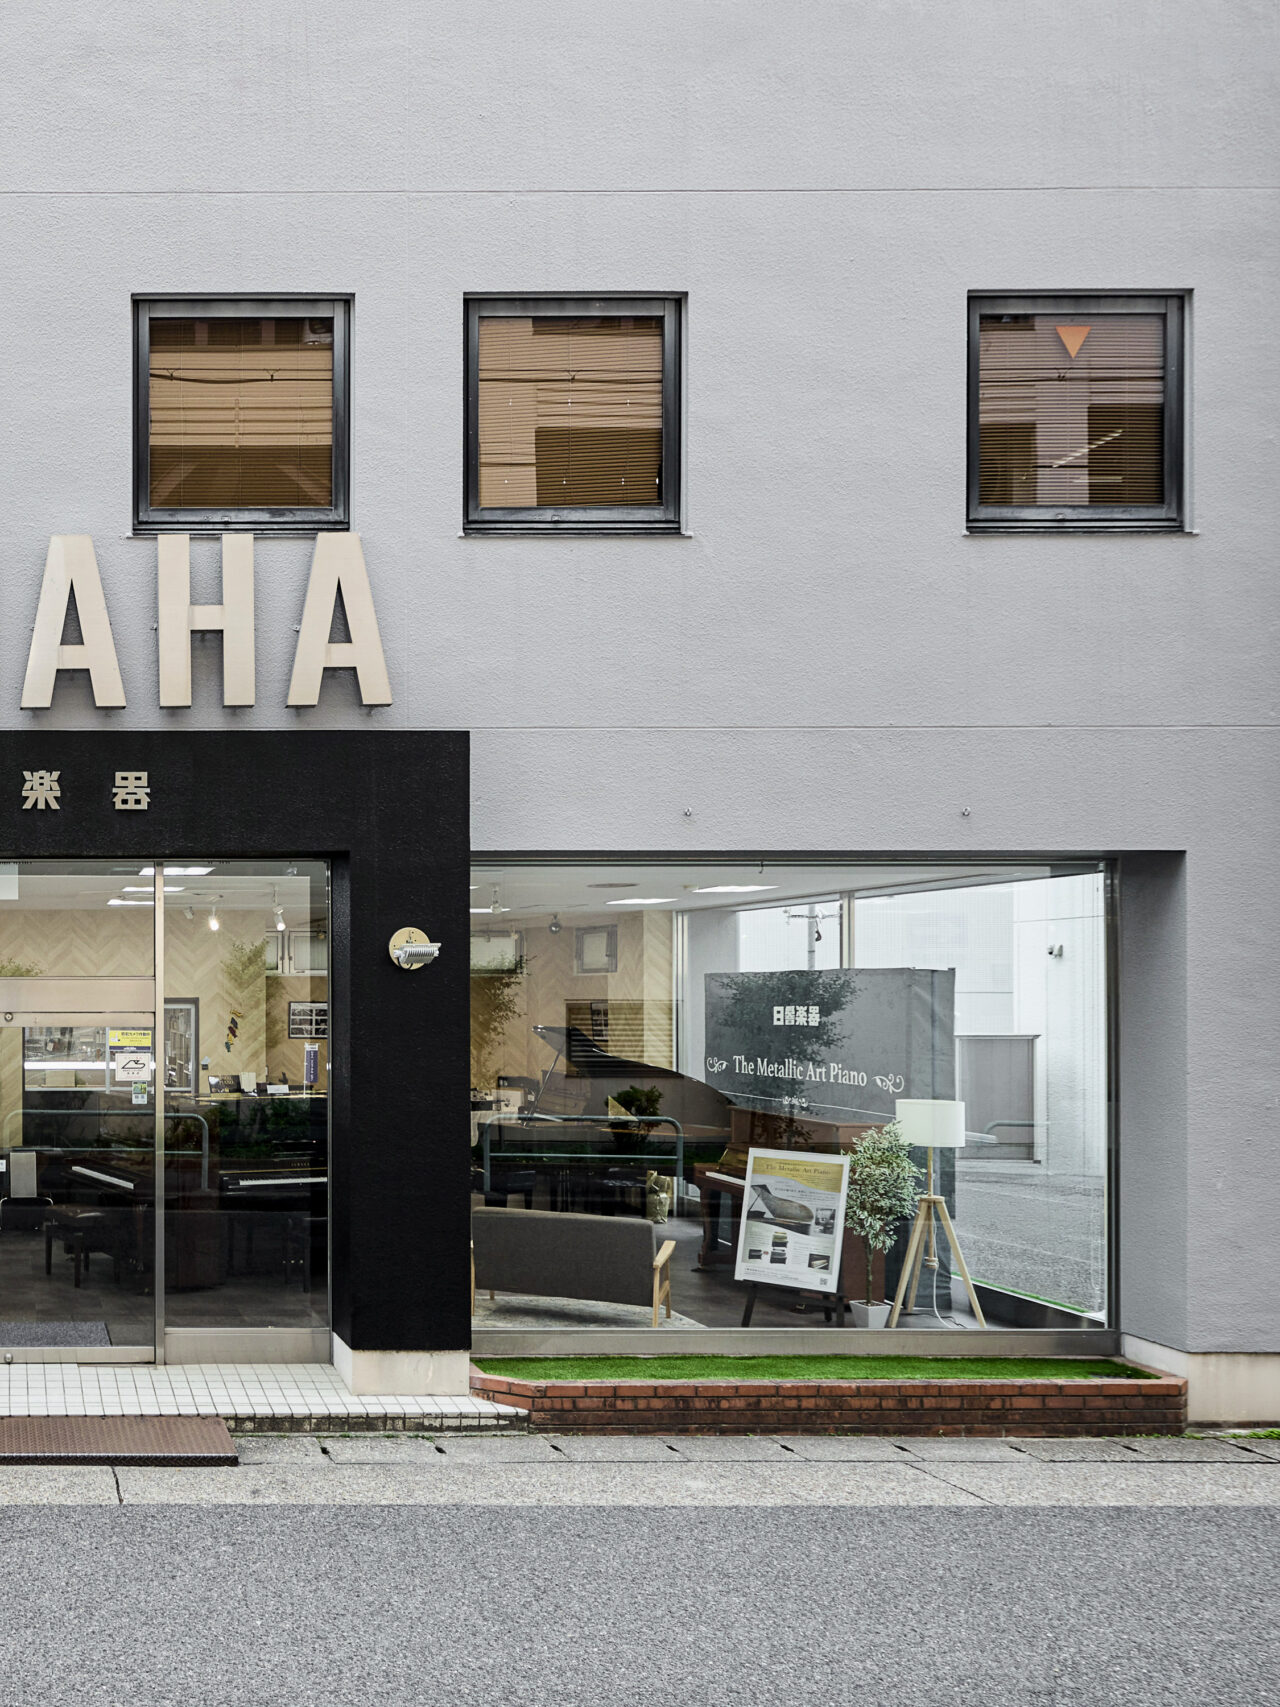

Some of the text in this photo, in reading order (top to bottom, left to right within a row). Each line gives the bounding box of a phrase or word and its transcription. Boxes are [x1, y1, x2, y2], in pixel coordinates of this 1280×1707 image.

[773, 1005, 820, 1026] 日響楽器
[733, 1055, 868, 1087] The Metallic Art Piano
